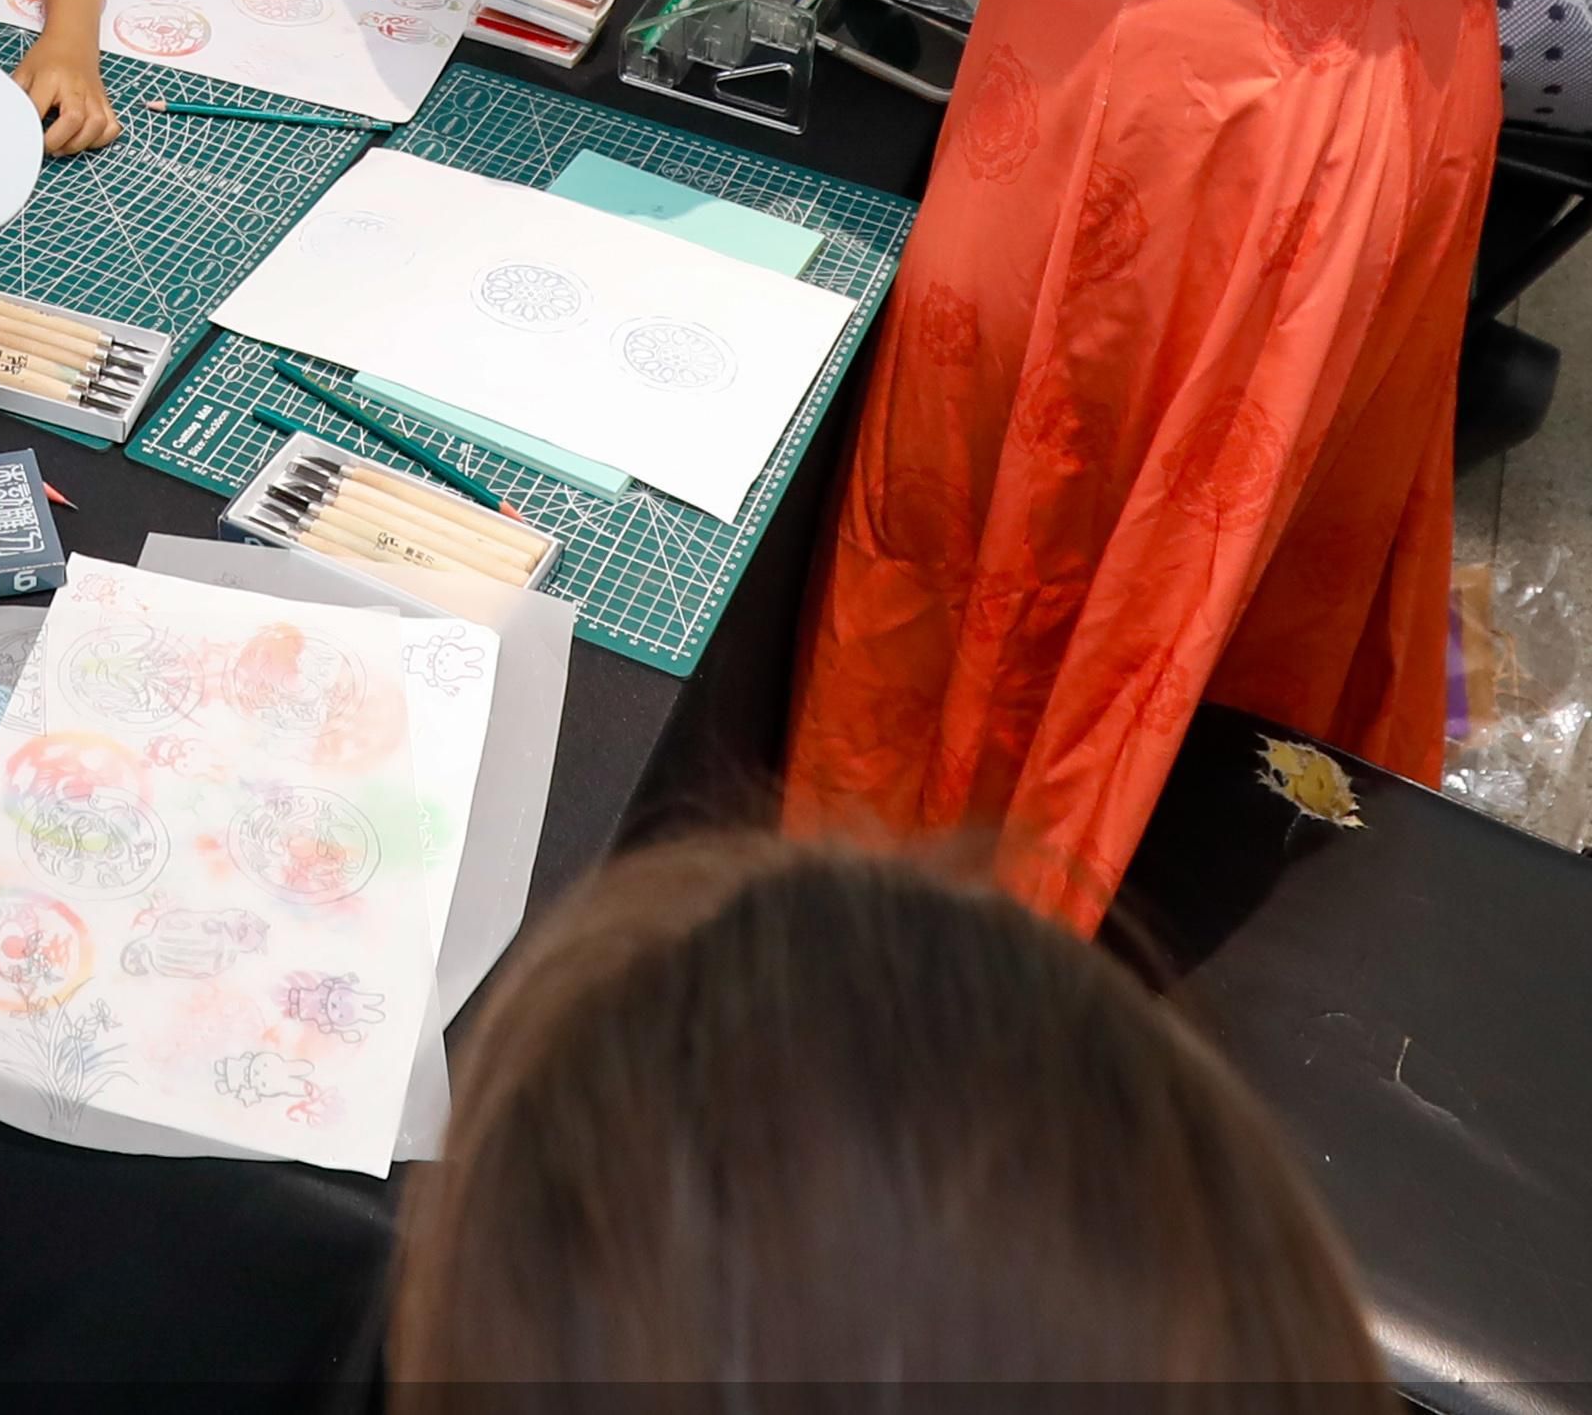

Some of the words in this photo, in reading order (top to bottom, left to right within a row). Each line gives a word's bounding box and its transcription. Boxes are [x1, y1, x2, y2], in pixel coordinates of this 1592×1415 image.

[172, 421, 202, 449] Cutting
[195, 405, 214, 420] Mat
[13, 568, 38, 592] 6
